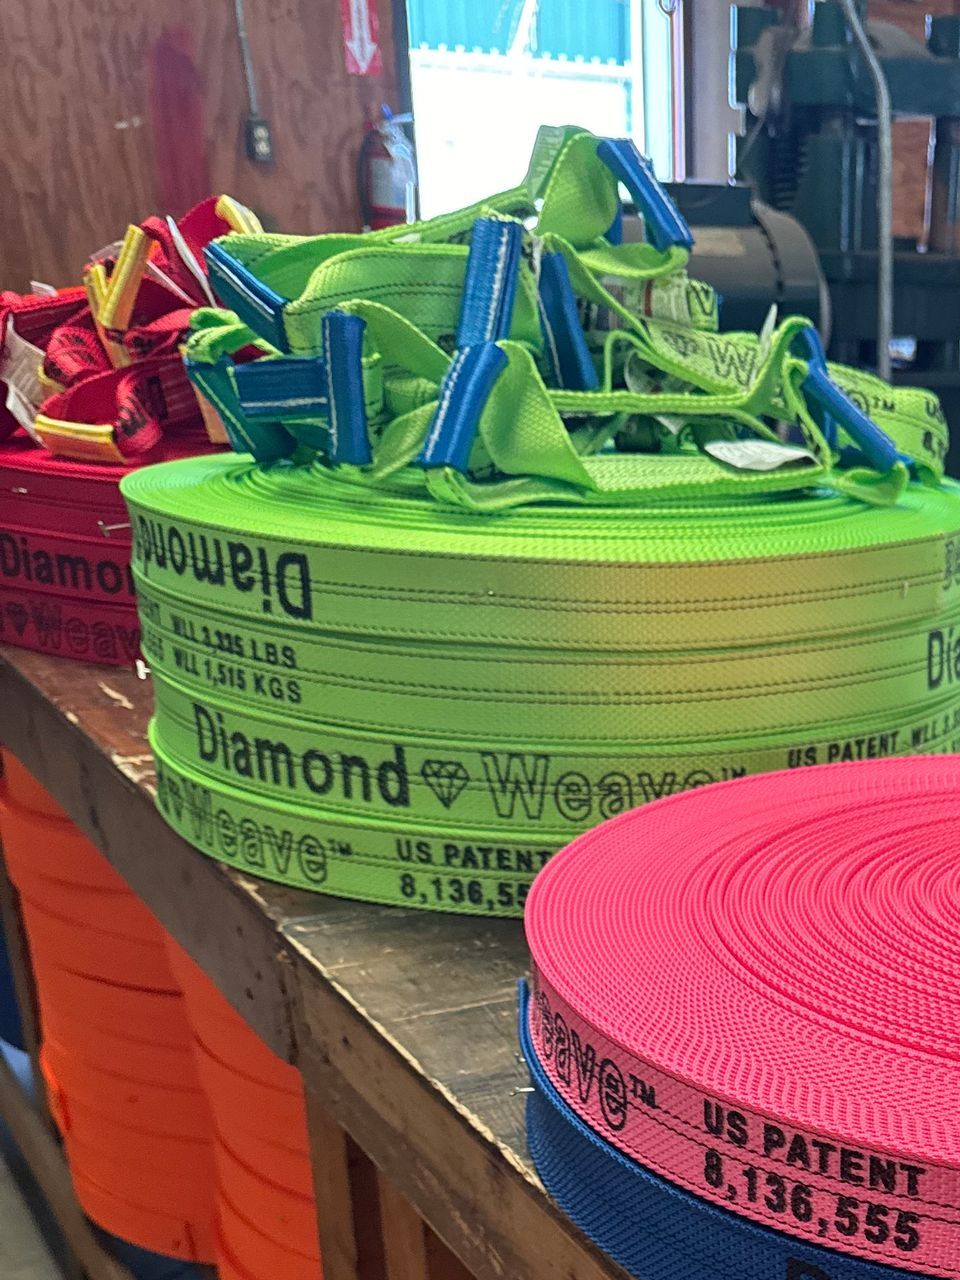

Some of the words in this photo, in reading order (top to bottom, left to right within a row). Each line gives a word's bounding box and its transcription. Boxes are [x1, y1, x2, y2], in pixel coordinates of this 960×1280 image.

[250, 637, 298, 670] LBS
[252, 673, 302, 703] KGS
[192, 702, 411, 808] Diamond
[787, 745, 818, 769] US
[826, 730, 900, 764] PATENT
[396, 839, 432, 864] US
[443, 844, 552, 874] PATENT
[703, 1099, 749, 1147] US
[759, 1122, 927, 1197] PATENT
[703, 1149, 921, 1252] 8,136,555
